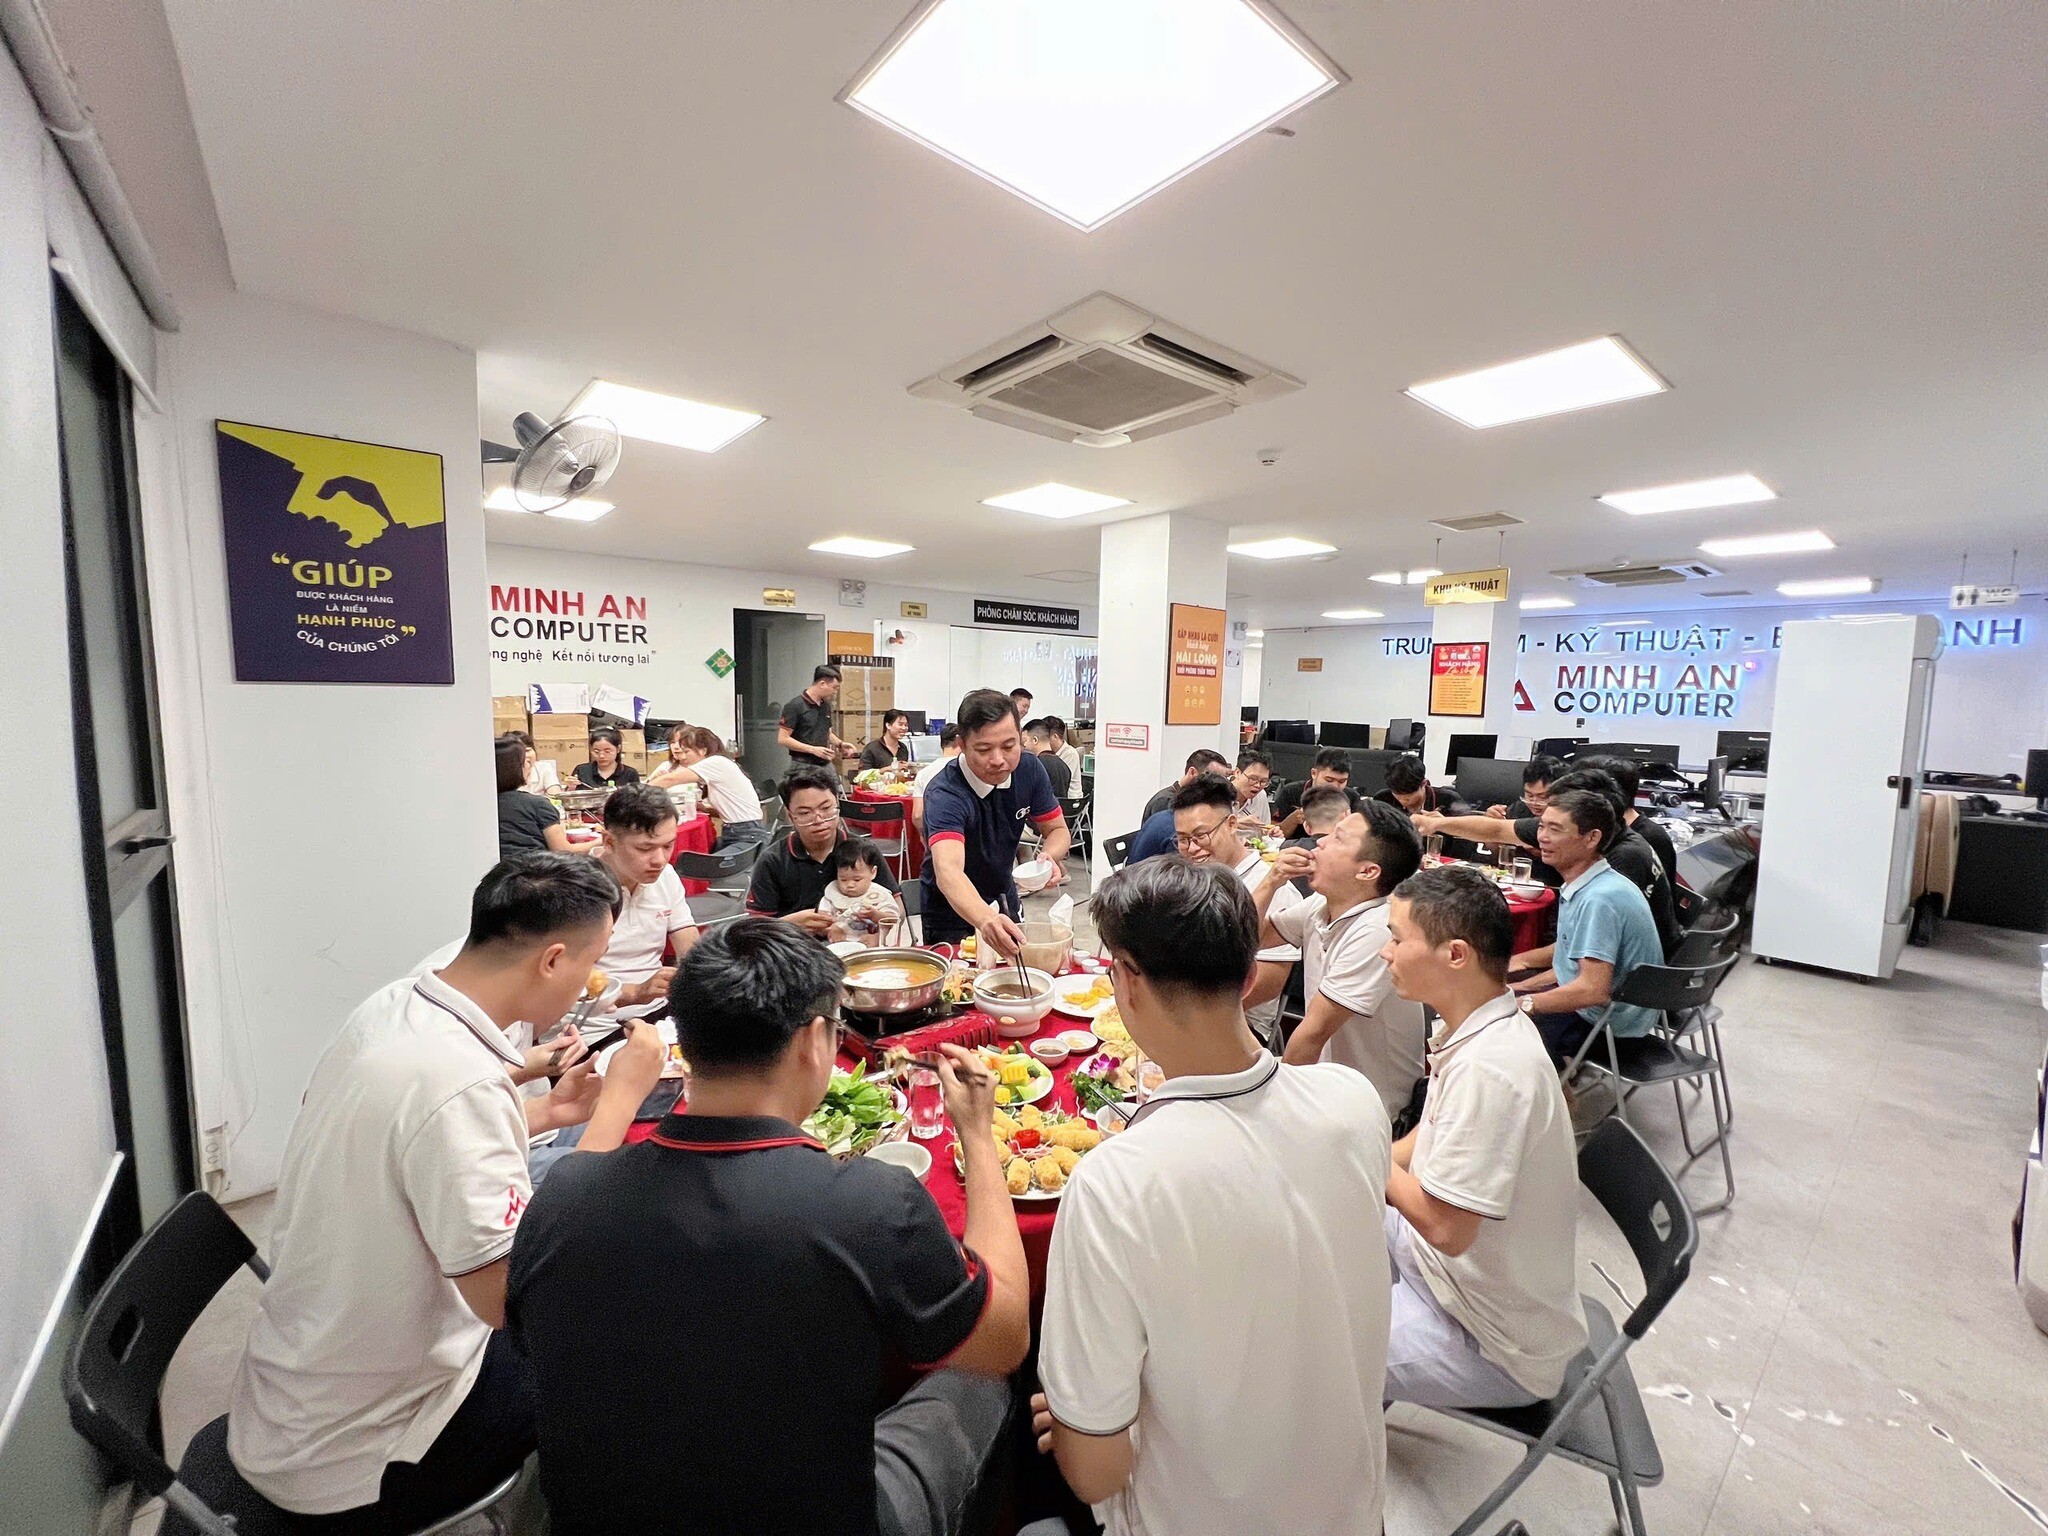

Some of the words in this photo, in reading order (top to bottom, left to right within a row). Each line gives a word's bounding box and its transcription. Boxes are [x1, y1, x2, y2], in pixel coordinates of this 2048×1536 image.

[1433, 584, 1452, 595] KHU
[1469, 578, 1500, 593] THUẬT
[325, 603, 340, 612] LÀ
[328, 592, 364, 602] KHÁCH
[366, 595, 394, 604] HÀNG
[490, 585, 584, 616] MINH
[597, 594, 647, 621] AN
[297, 614, 346, 627] HẠNH
[351, 616, 396, 629] PHÚC
[1023, 608, 1036, 622] SÓC
[1037, 611, 1060, 624] KHÁCH
[1060, 613, 1078, 626] HÀNG
[490, 616, 648, 644] COMPUTER
[1555, 626, 1600, 653] KỸ
[1615, 623, 1731, 657] THUẬT
[1953, 618, 2022, 646] NH
[296, 630, 324, 648] CỦA
[328, 641, 378, 653] CHÚNG
[490, 650, 508, 662] ng
[512, 649, 543, 663] nghệ
[552, 648, 573, 662] Kết
[577, 648, 595, 662] nối
[598, 652, 634, 666] tương
[1439, 660, 1461, 668] KHÁCH
[1557, 665, 1657, 690] MINH
[1674, 664, 1738, 691] AN
[1554, 691, 1735, 718] COMPUTER
